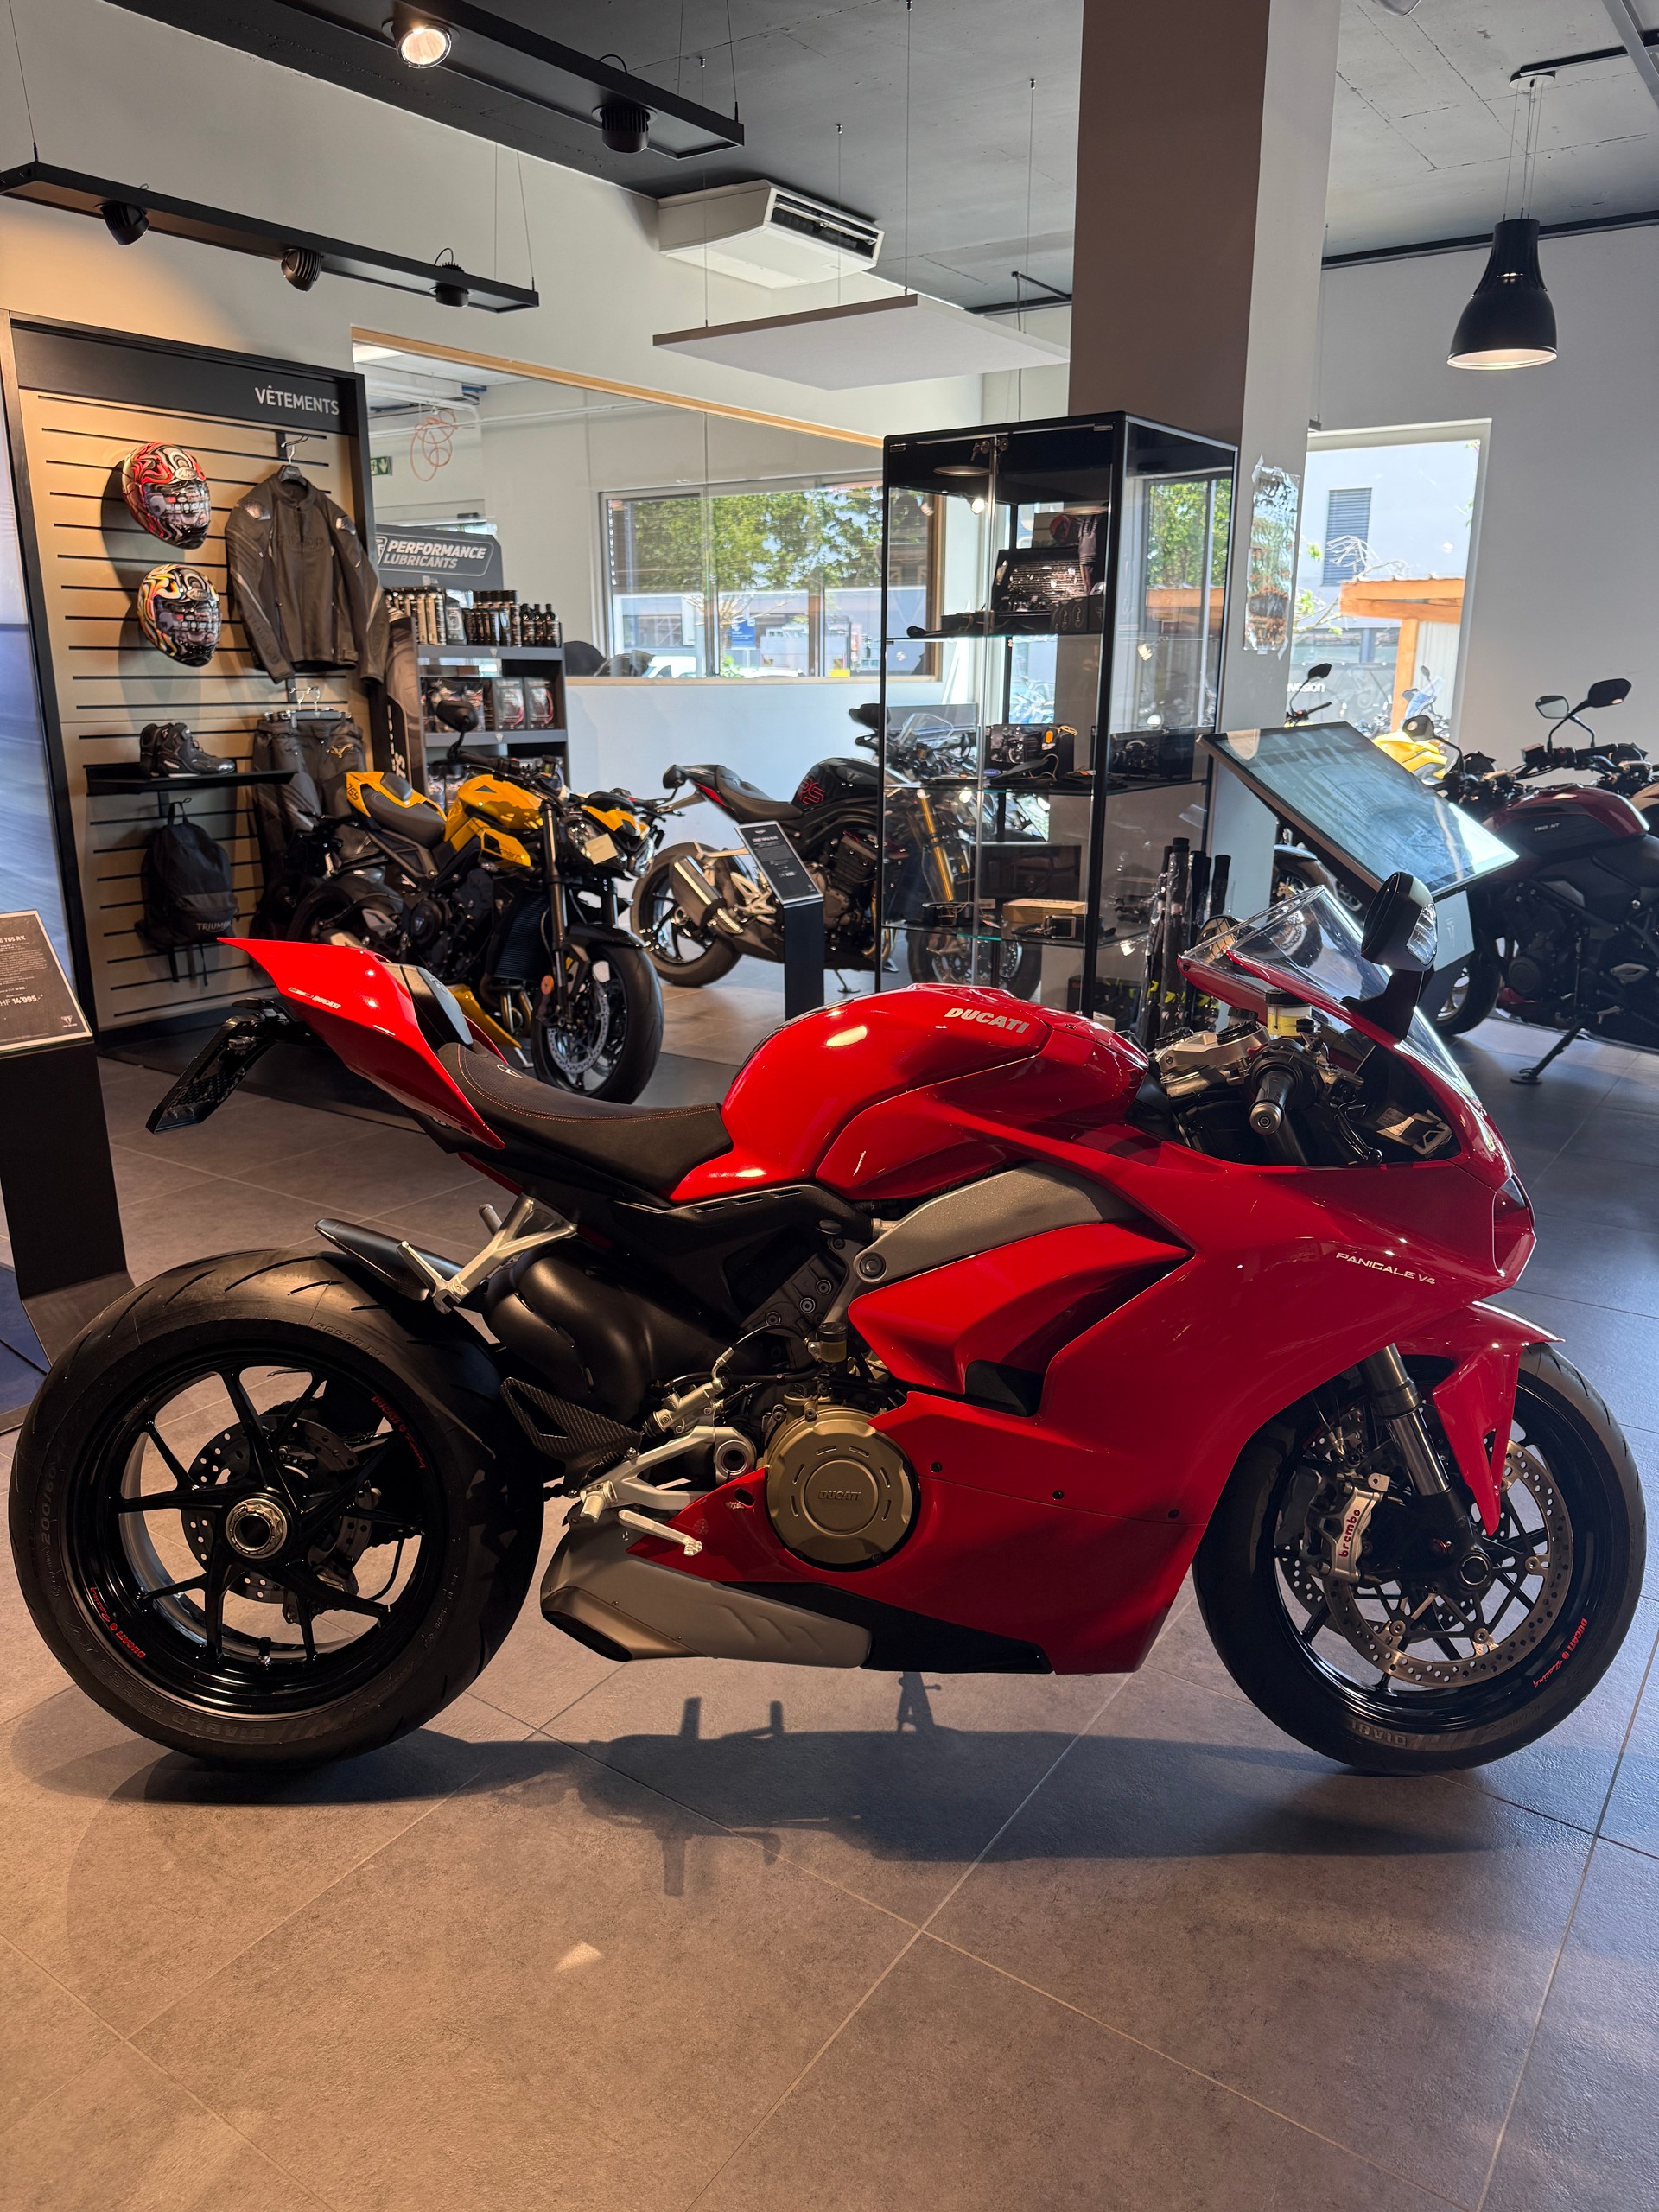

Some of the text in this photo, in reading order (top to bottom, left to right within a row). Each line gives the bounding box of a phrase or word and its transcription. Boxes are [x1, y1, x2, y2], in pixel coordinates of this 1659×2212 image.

[254, 385, 340, 416] VÊTEMENTS
[383, 552, 458, 569] LUBRICANTS
[387, 539, 487, 560] PERFORMANCE
[944, 1007, 1030, 1034] DUCATI
[1336, 1252, 1436, 1285] PANIGALE V4
[818, 1490, 862, 1501] DUCATI
[1338, 1509, 1361, 1558] brembo
[116, 1630, 146, 1659] DUCATI
[1567, 1618, 1588, 1652] DUCATI
[1349, 1717, 1408, 1747] DIABL
